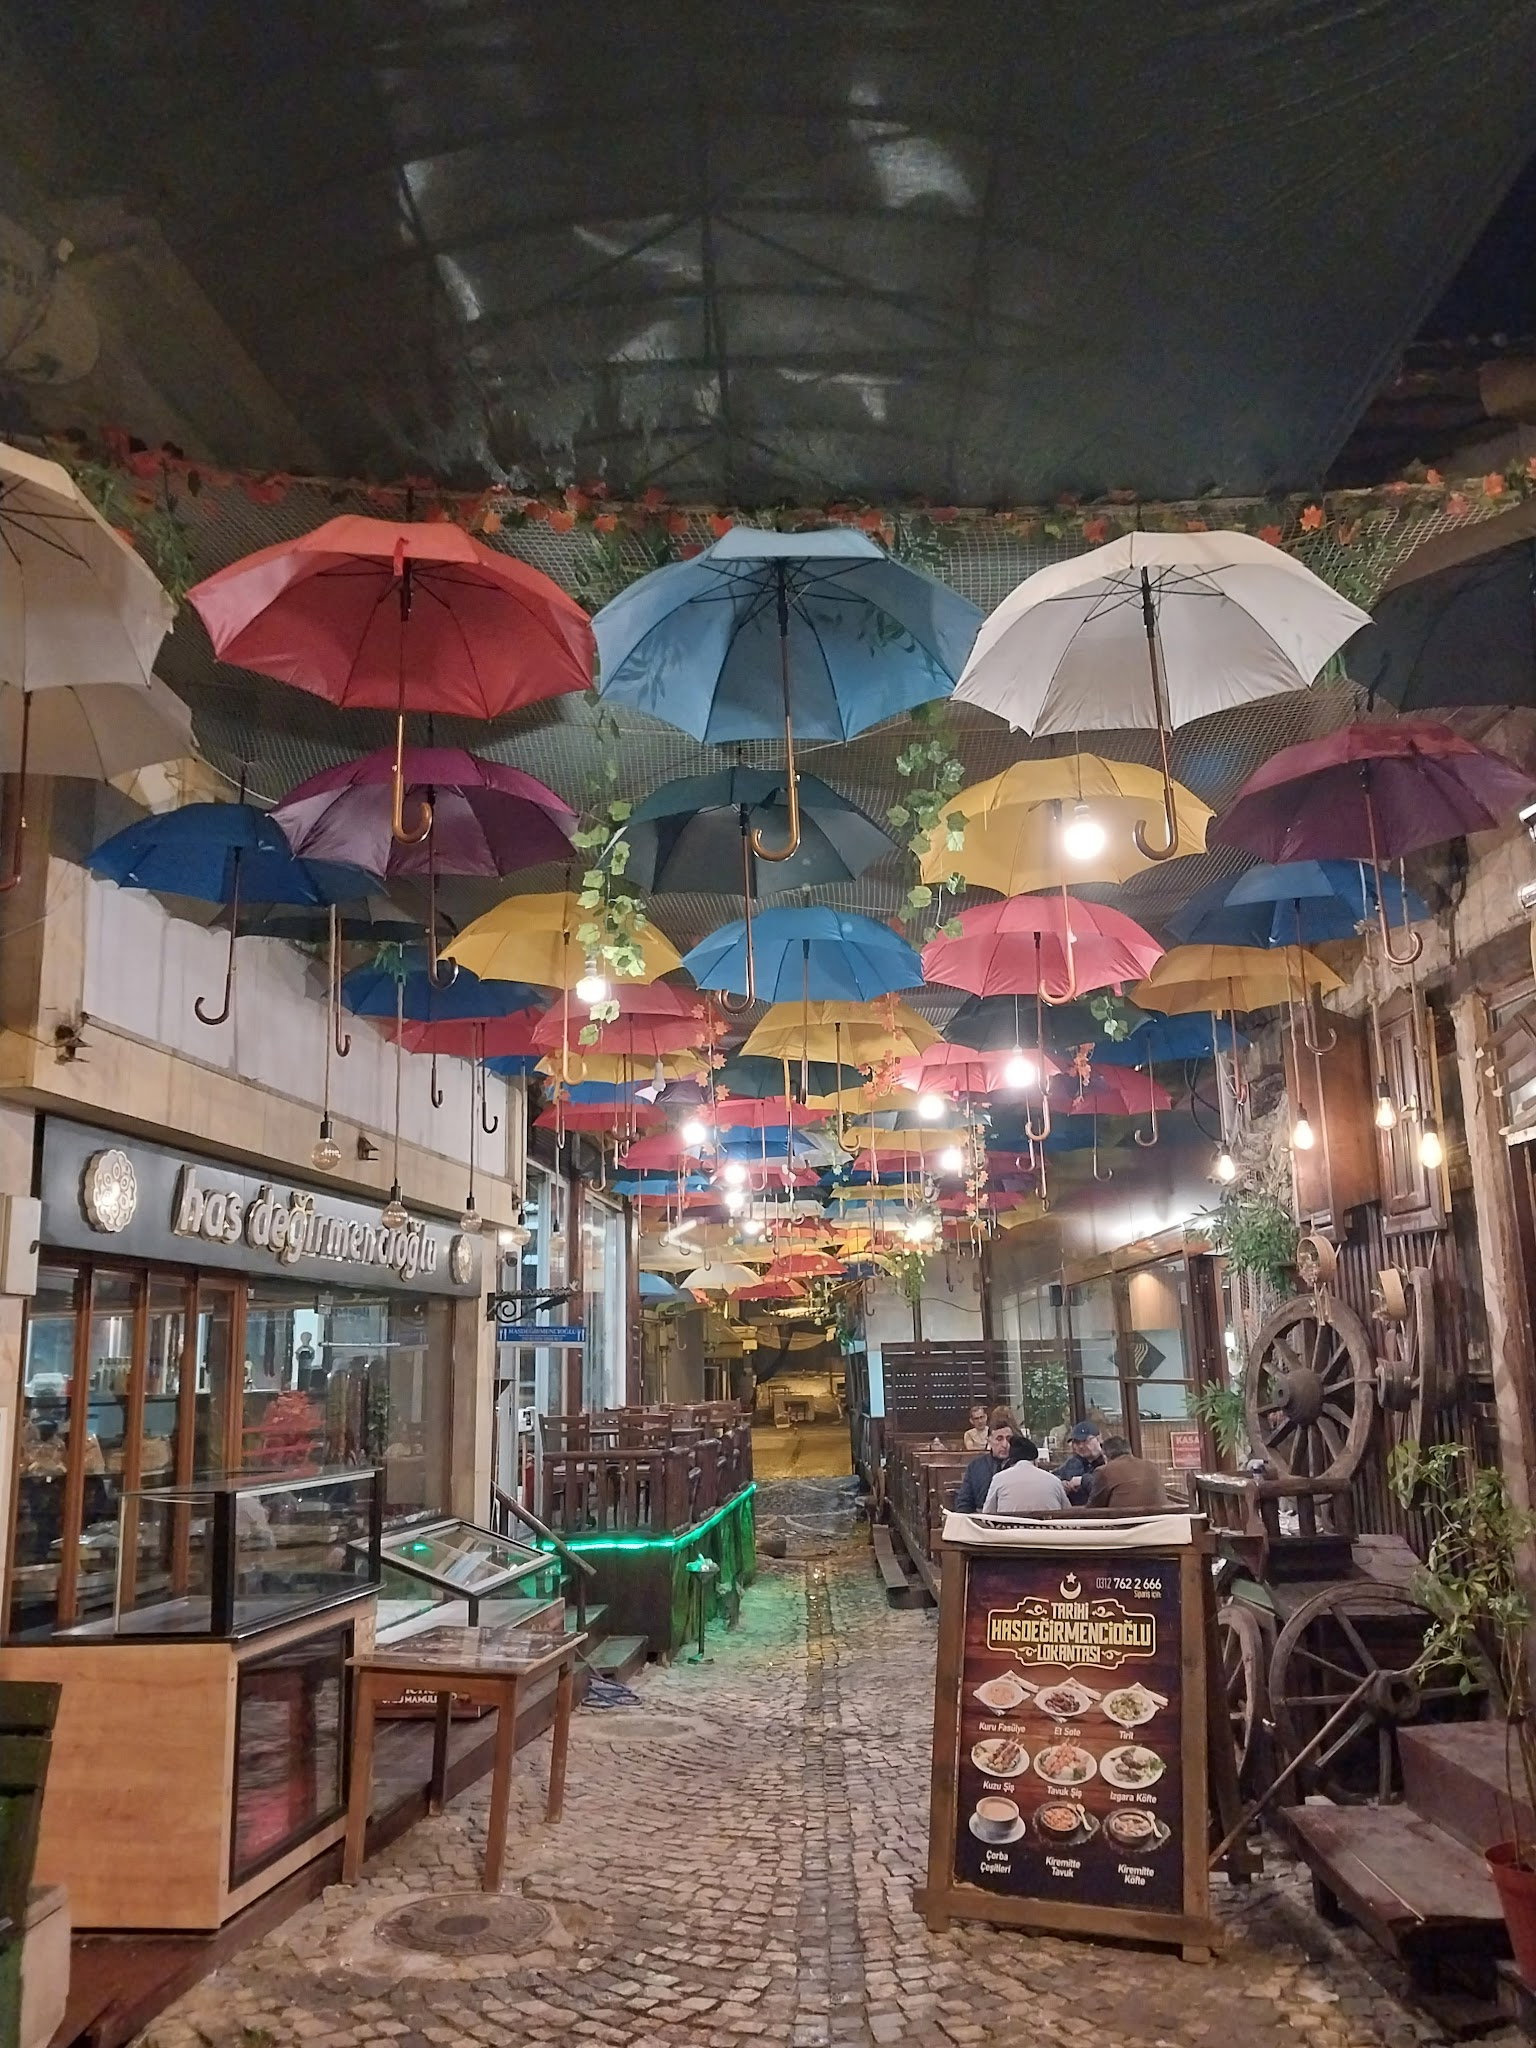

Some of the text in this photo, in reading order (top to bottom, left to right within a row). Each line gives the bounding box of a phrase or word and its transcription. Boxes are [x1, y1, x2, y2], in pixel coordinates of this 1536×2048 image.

[173, 1164, 242, 1243] has
[1096, 1577, 1162, 1590] 0312 762 2 666
[1051, 1602, 1089, 1620] TARİHİ
[991, 1617, 1151, 1646] HASDEĞİRMENCİOĞLU
[1037, 1644, 1100, 1663] LOKANTASI
[979, 1721, 1026, 1735] Kuru Fasülye
[1054, 1727, 1081, 1737] Et Sote
[1119, 1730, 1134, 1740] Tirit
[983, 1780, 1015, 1793] Kuzu Şiş
[1047, 1785, 1082, 1799] Tavuk Şiş
[1136, 1793, 1157, 1804] Köfte
[986, 1850, 1009, 1862] Çorba
[1045, 1856, 1081, 1869] Kiremitte
[980, 1862, 1011, 1874] Çeşitleri
[1052, 1867, 1074, 1878] Tavuk
[1118, 1863, 1155, 1877] Kiremitte
[1124, 1874, 1146, 1886] Köfte
